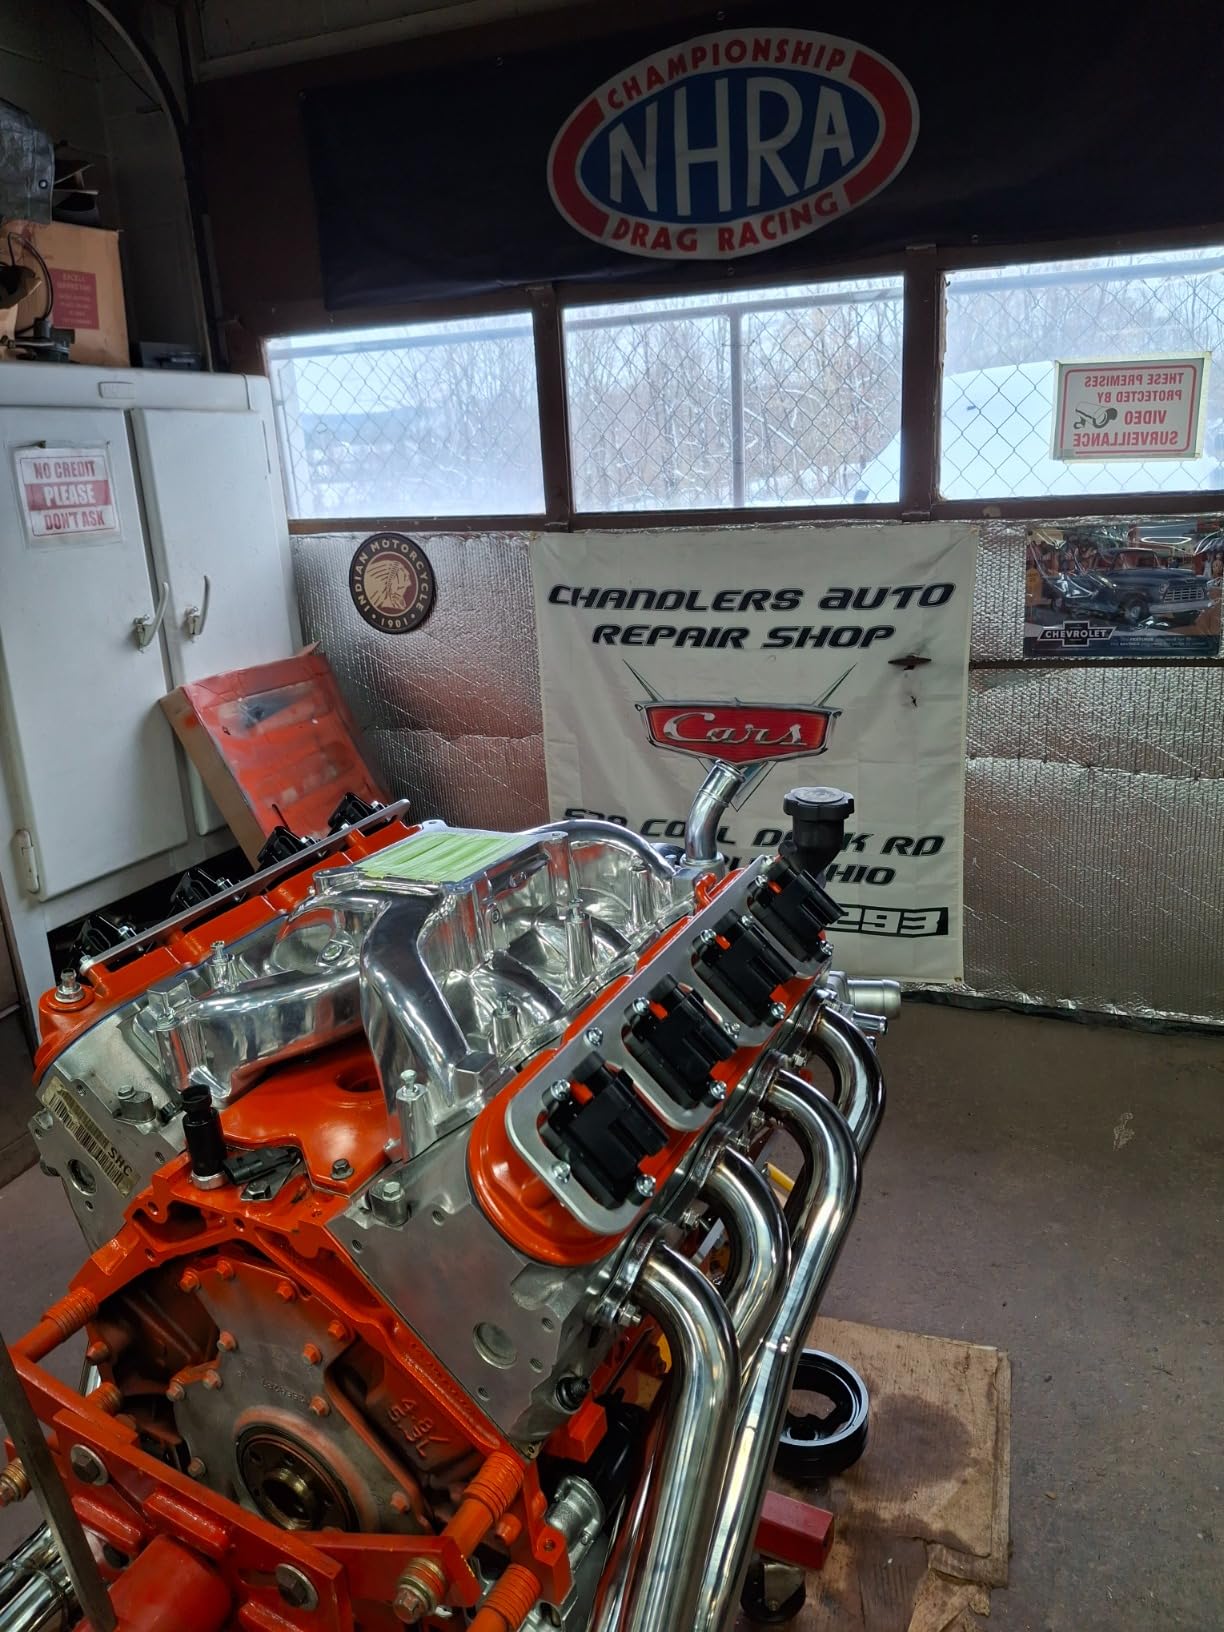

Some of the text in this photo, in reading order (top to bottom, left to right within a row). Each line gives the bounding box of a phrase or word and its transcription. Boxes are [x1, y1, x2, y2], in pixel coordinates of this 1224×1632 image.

[604, 38, 847, 112] CHAMPIONSHIP
[608, 76, 855, 217] NHRA
[611, 191, 839, 252] DRAG RACING
[33, 460, 96, 479] NO CREDIT
[43, 484, 97, 507] PLEASE
[44, 510, 105, 530] DON'T ASK
[354, 539, 429, 612] INDIAN MOTORCYCLE
[548, 583, 956, 612] CHANDLERS AUTO
[381, 617, 408, 628] 1901
[1045, 629, 1107, 639] CHEVROLET
[592, 624, 896, 649] REPAIR SHOP
[663, 712, 807, 746] Cars
[640, 819, 736, 845] COL
[880, 835, 945, 857] RD
[826, 863, 897, 886] HIO
